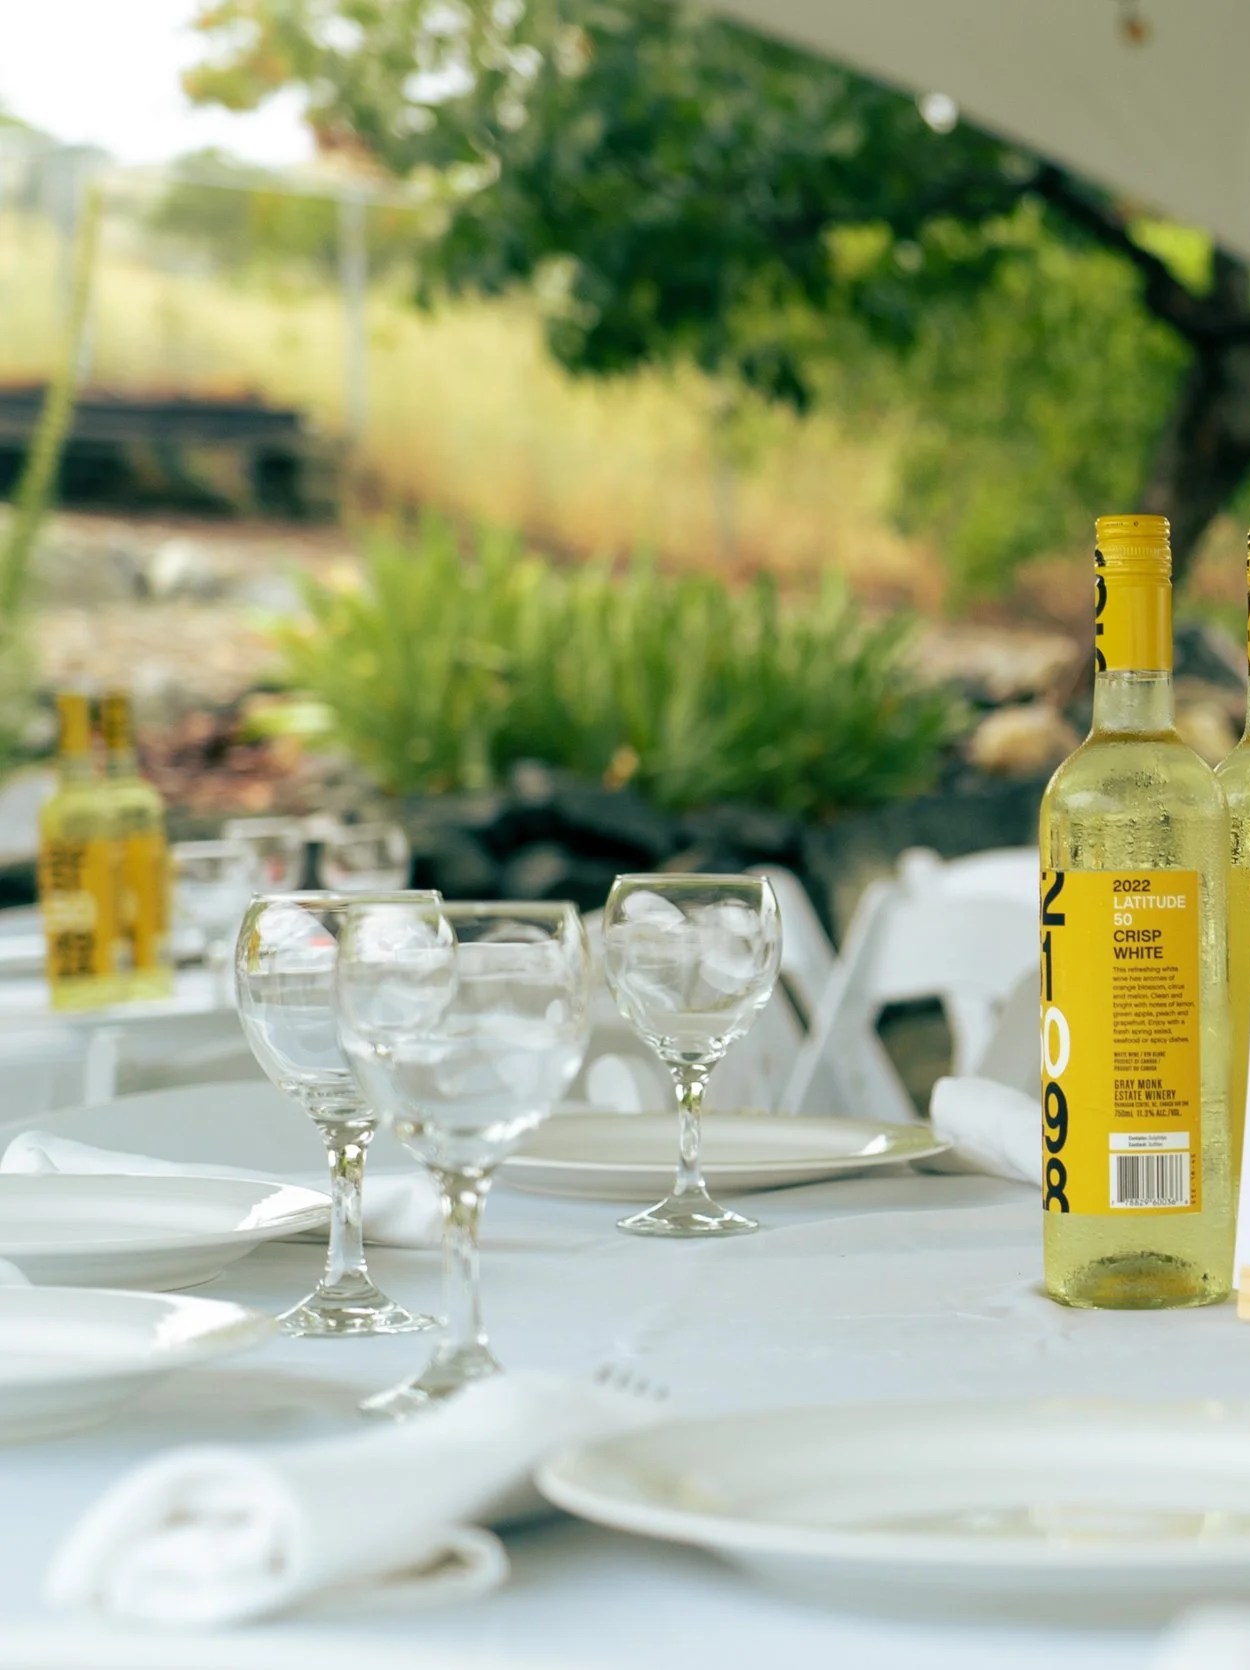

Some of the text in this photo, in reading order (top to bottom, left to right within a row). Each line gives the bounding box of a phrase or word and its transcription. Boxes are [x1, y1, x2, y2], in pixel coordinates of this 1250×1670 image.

[1113, 879, 1151, 892] 2022
[1113, 895, 1187, 909] LATITUDE
[1113, 912, 1133, 926] 50
[1113, 929, 1162, 943] CRISP
[1113, 946, 1164, 960] WHITE
[1127, 966, 1160, 974] refreshing
[1114, 1079, 1163, 1089] GRAY MONK
[1114, 1089, 1176, 1101] ESTATE WINERY
